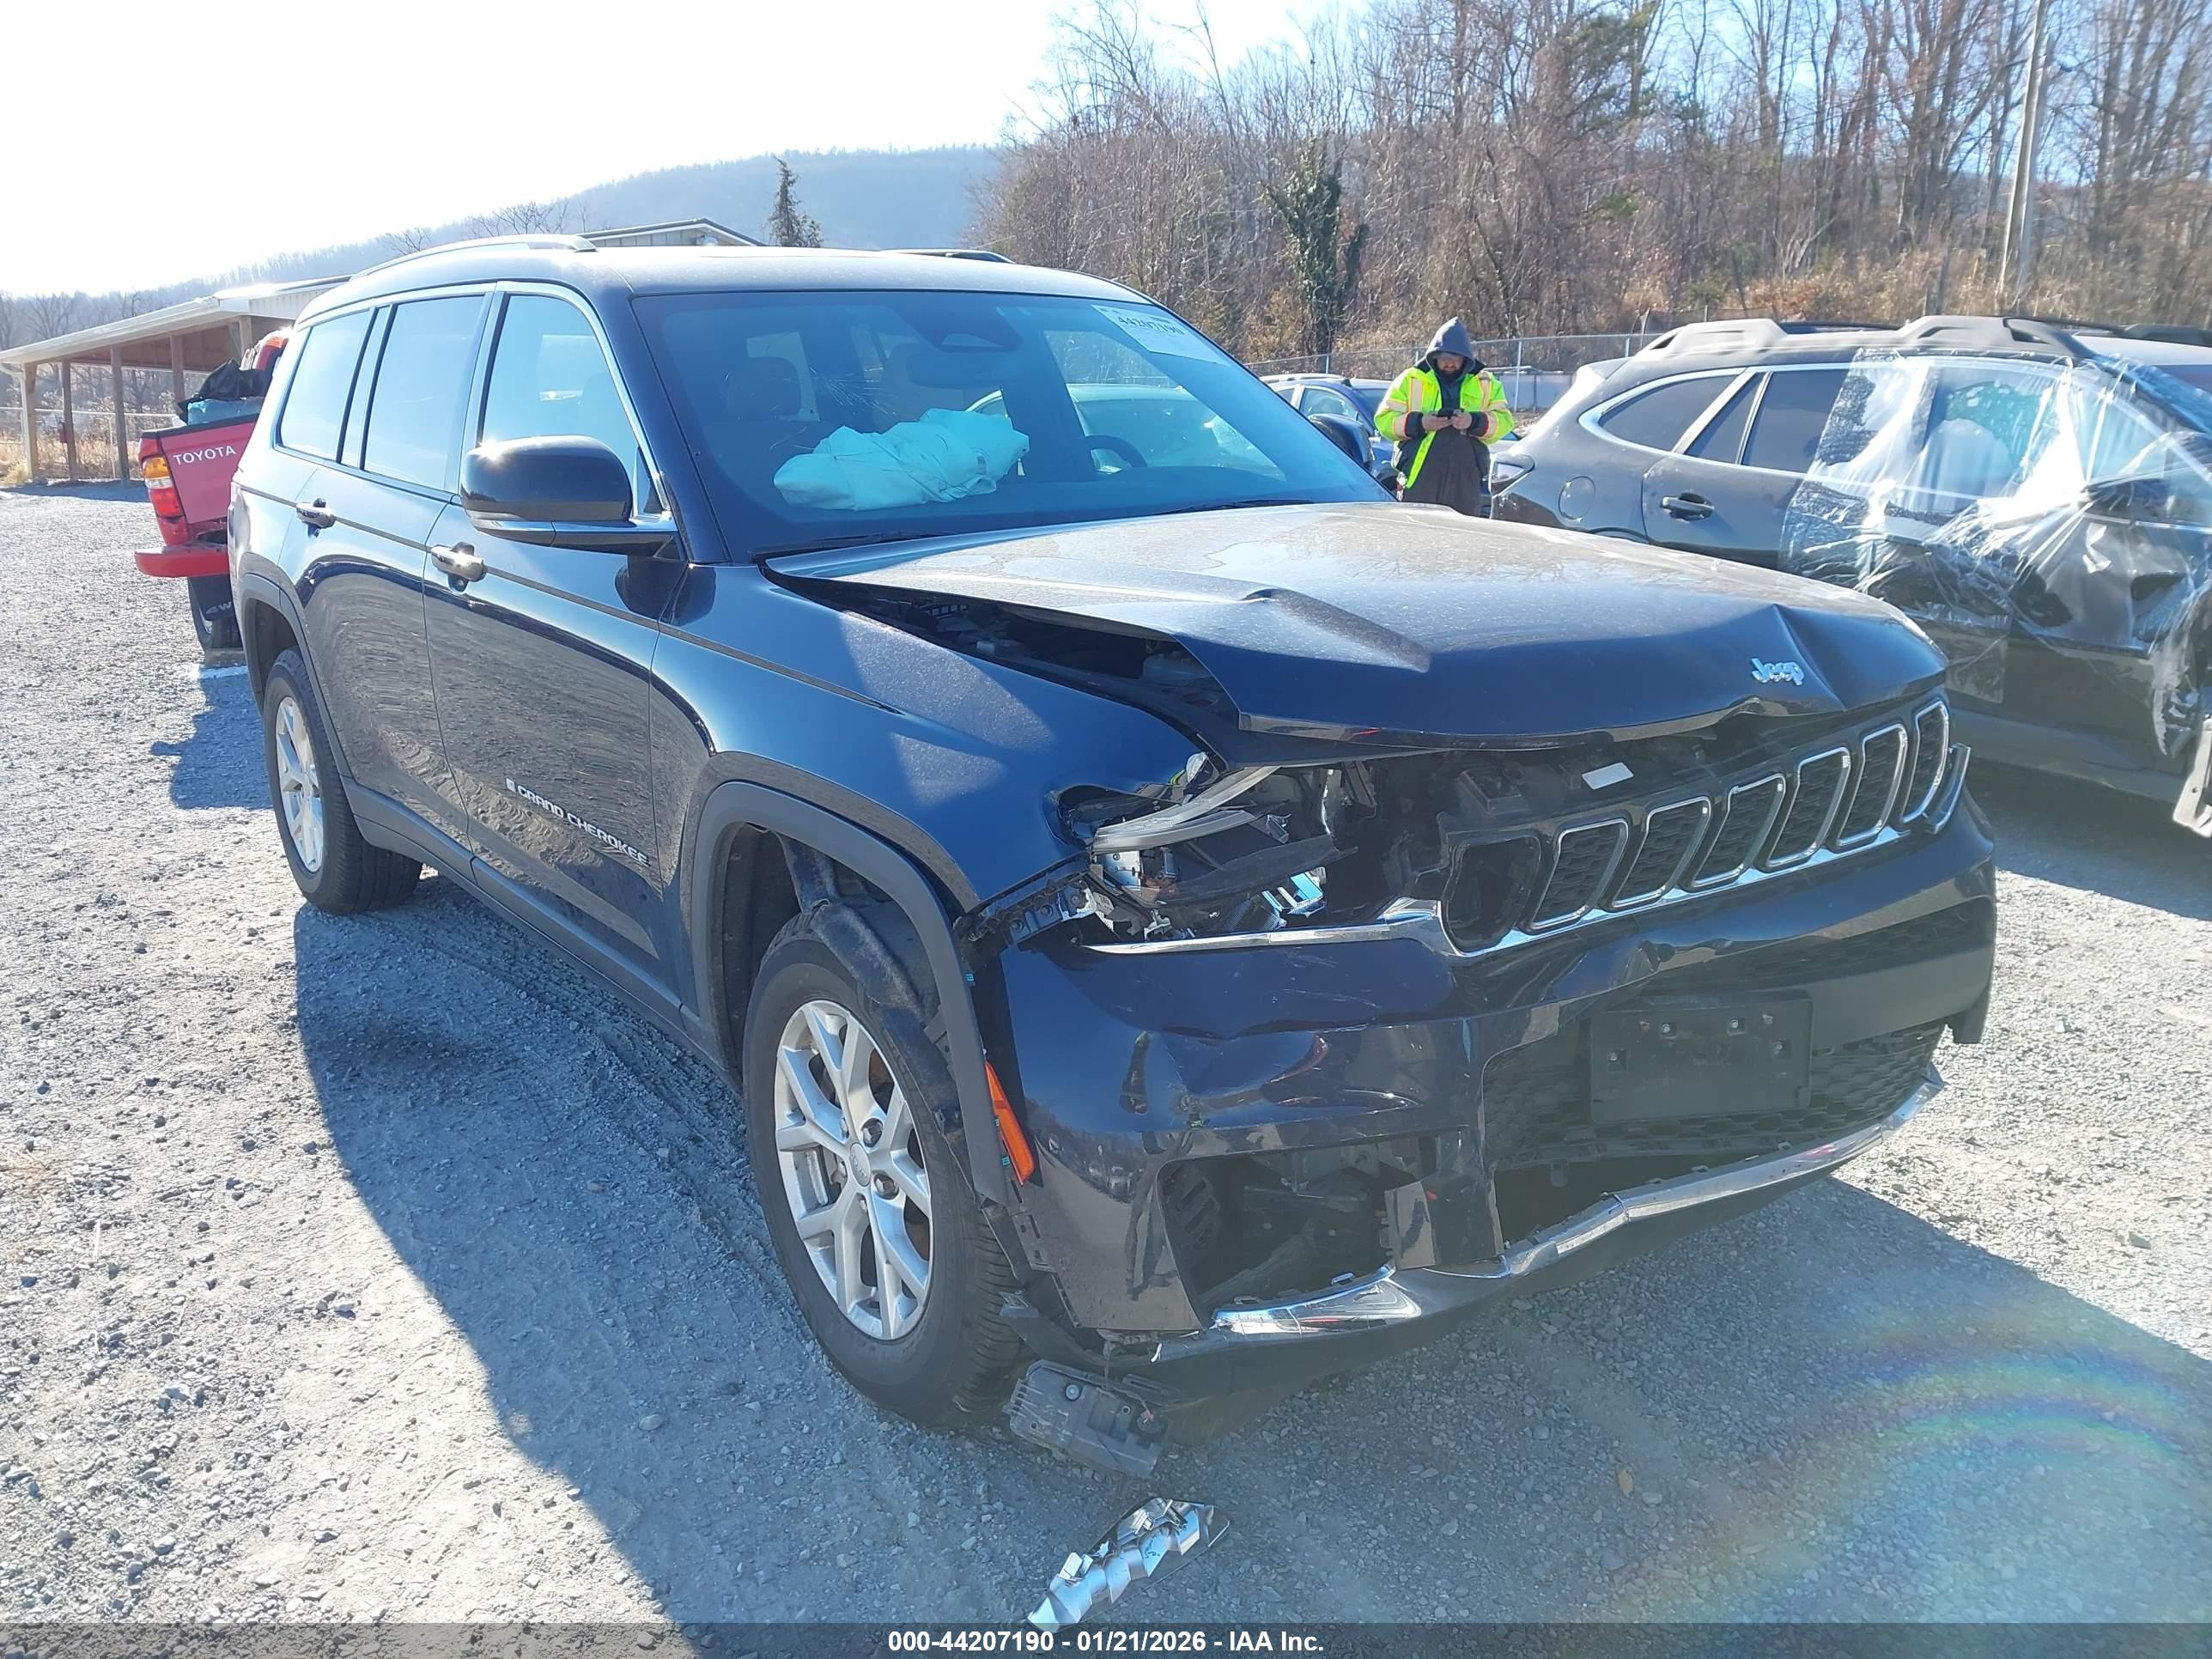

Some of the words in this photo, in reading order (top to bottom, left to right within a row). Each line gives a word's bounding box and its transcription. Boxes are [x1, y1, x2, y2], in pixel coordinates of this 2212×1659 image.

[173, 445, 237, 465] TOYOTA
[206, 601, 232, 614] 4W
[1751, 658, 1804, 686] Jeep
[517, 785, 564, 818] GRAND
[567, 812, 651, 867] CHEROKEE
